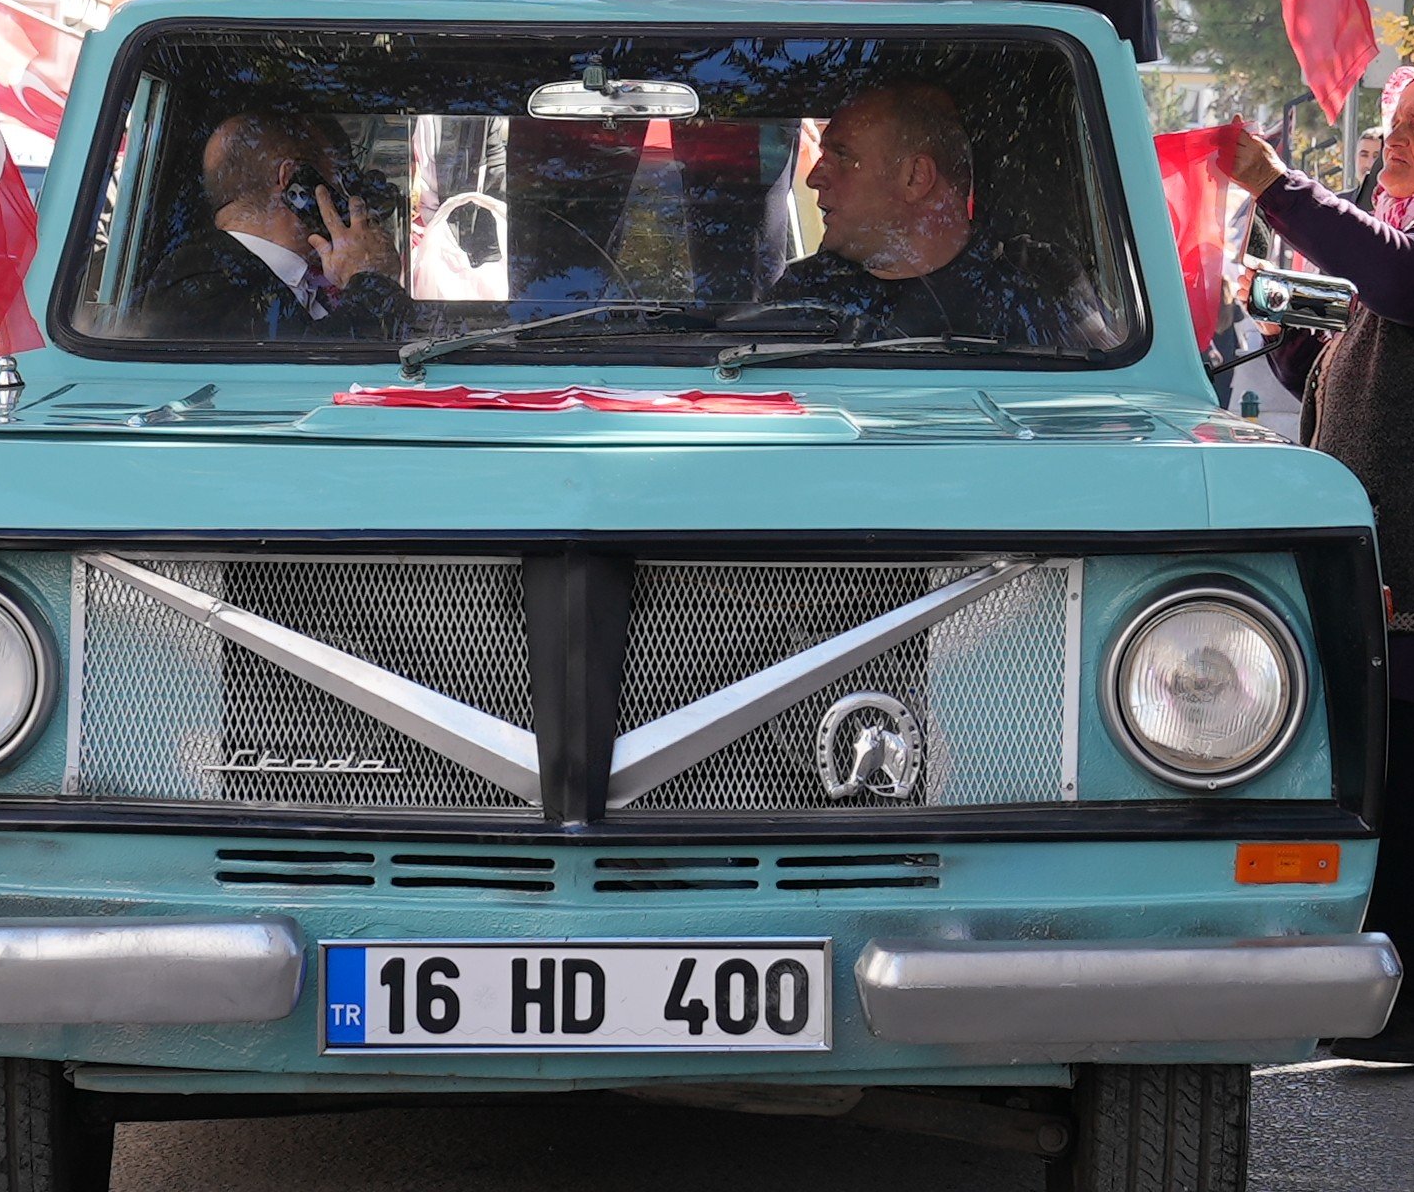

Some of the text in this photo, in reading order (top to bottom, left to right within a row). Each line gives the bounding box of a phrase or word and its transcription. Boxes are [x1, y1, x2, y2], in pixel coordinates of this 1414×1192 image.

[331, 957, 809, 1036] TR 16 HD 400
